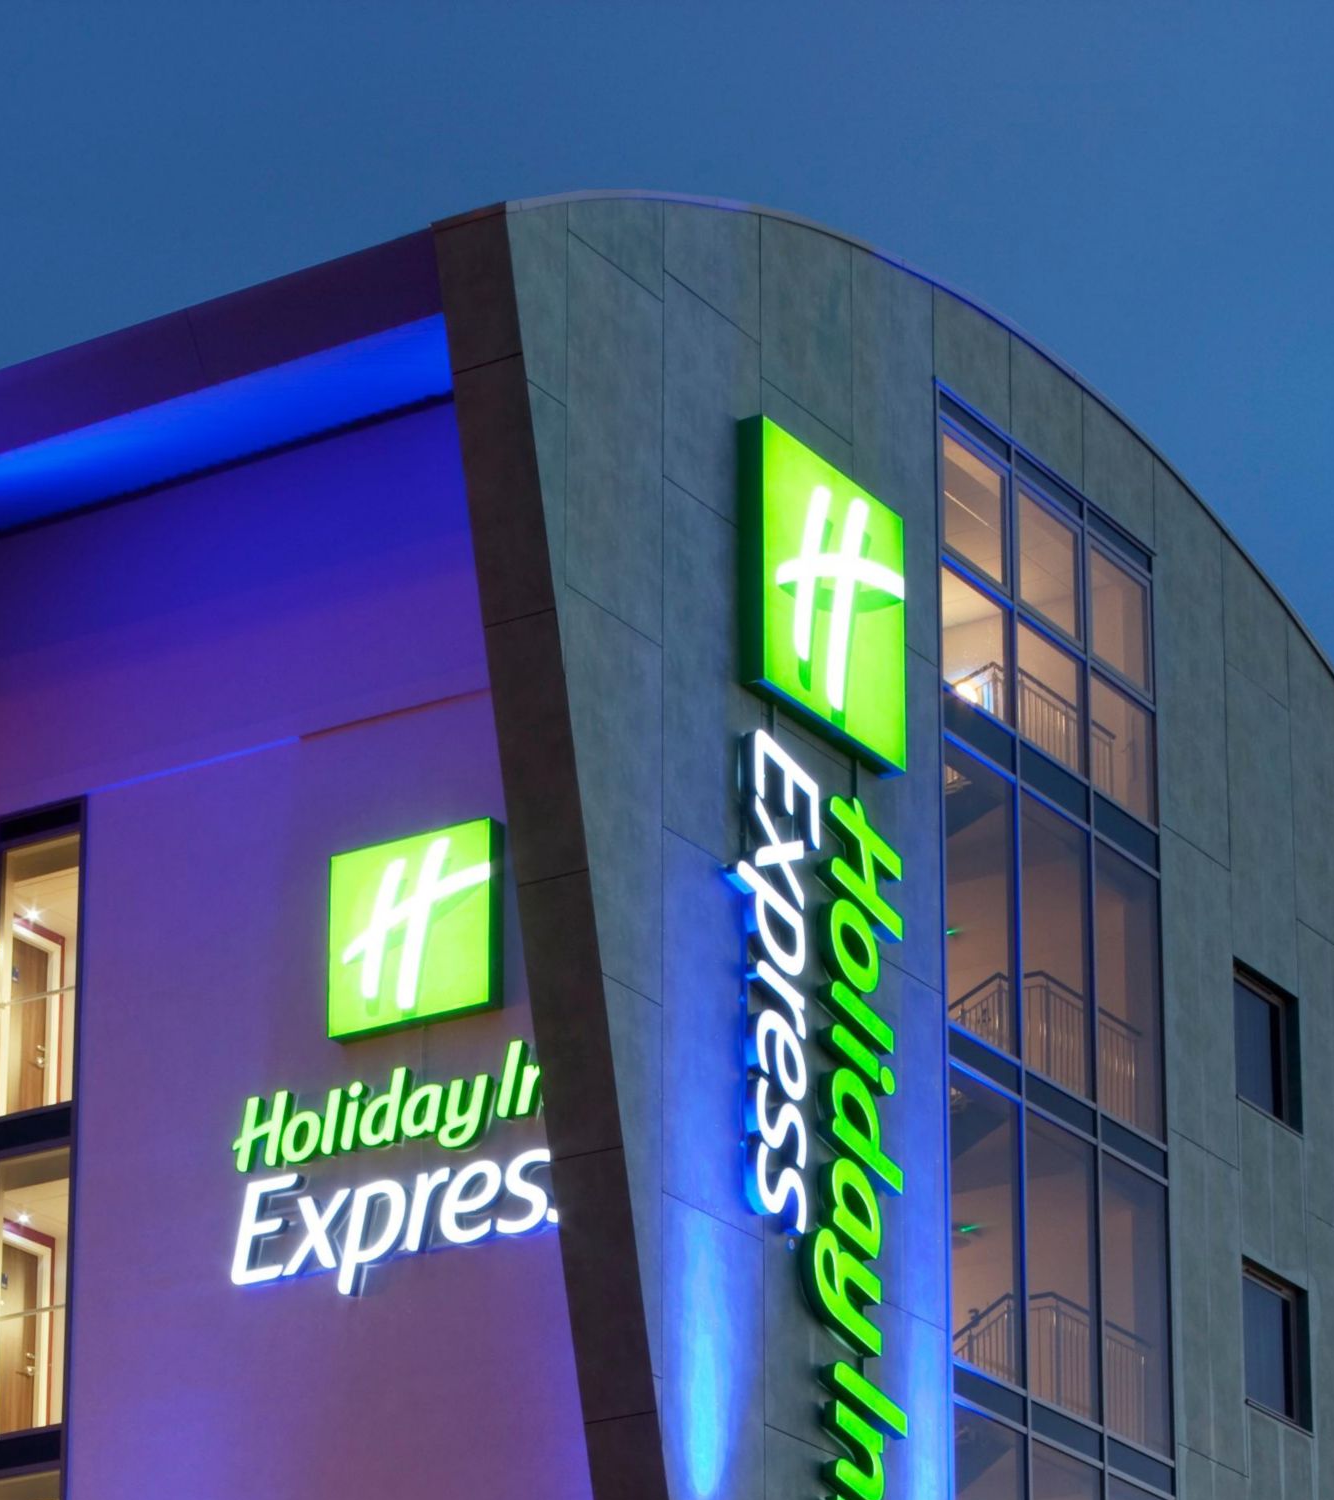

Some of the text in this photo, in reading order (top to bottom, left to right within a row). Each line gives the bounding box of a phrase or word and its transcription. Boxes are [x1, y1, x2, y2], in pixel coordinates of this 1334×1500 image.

[232, 1066, 493, 1173] Holiday
[737, 729, 821, 1235] Express
[813, 795, 903, 1357] Holiday
[230, 1147, 560, 1296] Expres
